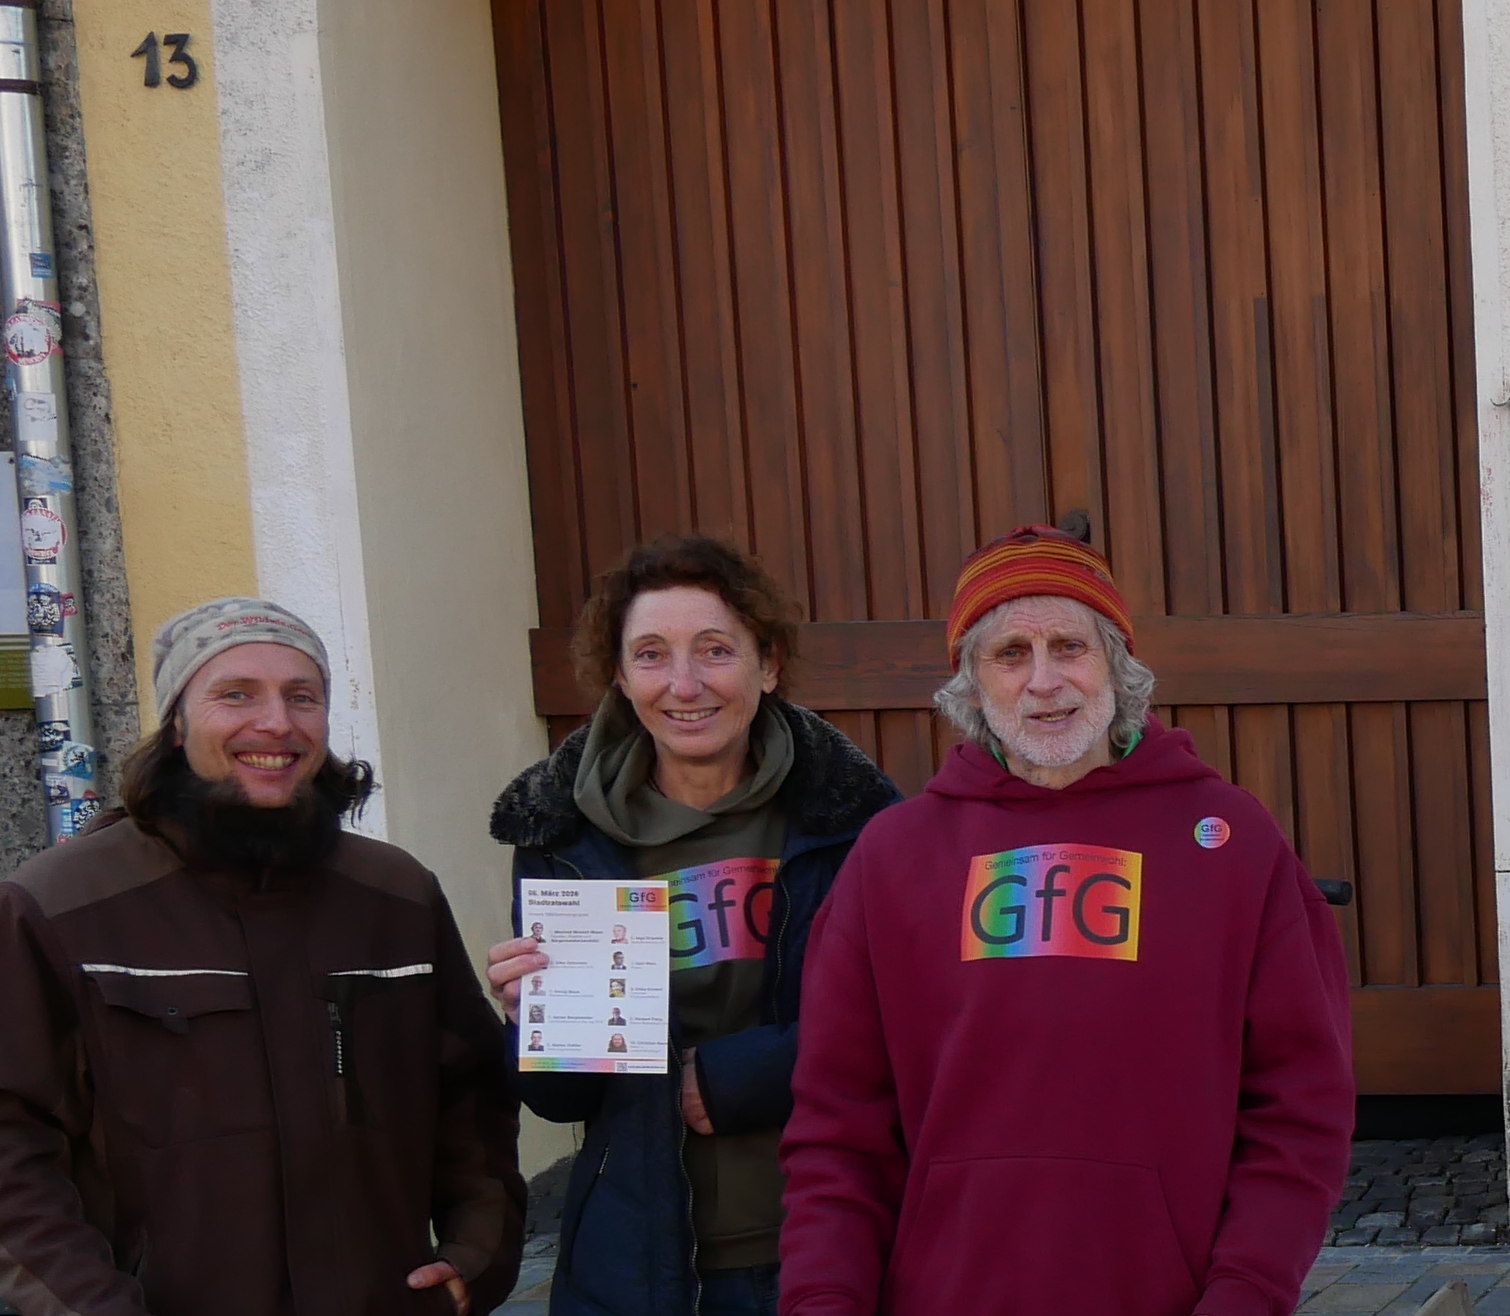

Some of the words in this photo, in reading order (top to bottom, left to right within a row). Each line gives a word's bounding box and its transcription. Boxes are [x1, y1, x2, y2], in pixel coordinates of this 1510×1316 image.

[130, 30, 198, 89] 13
[1201, 823, 1223, 833] GfG
[629, 891, 657, 904] GfG
[970, 864, 1132, 945] GfG
